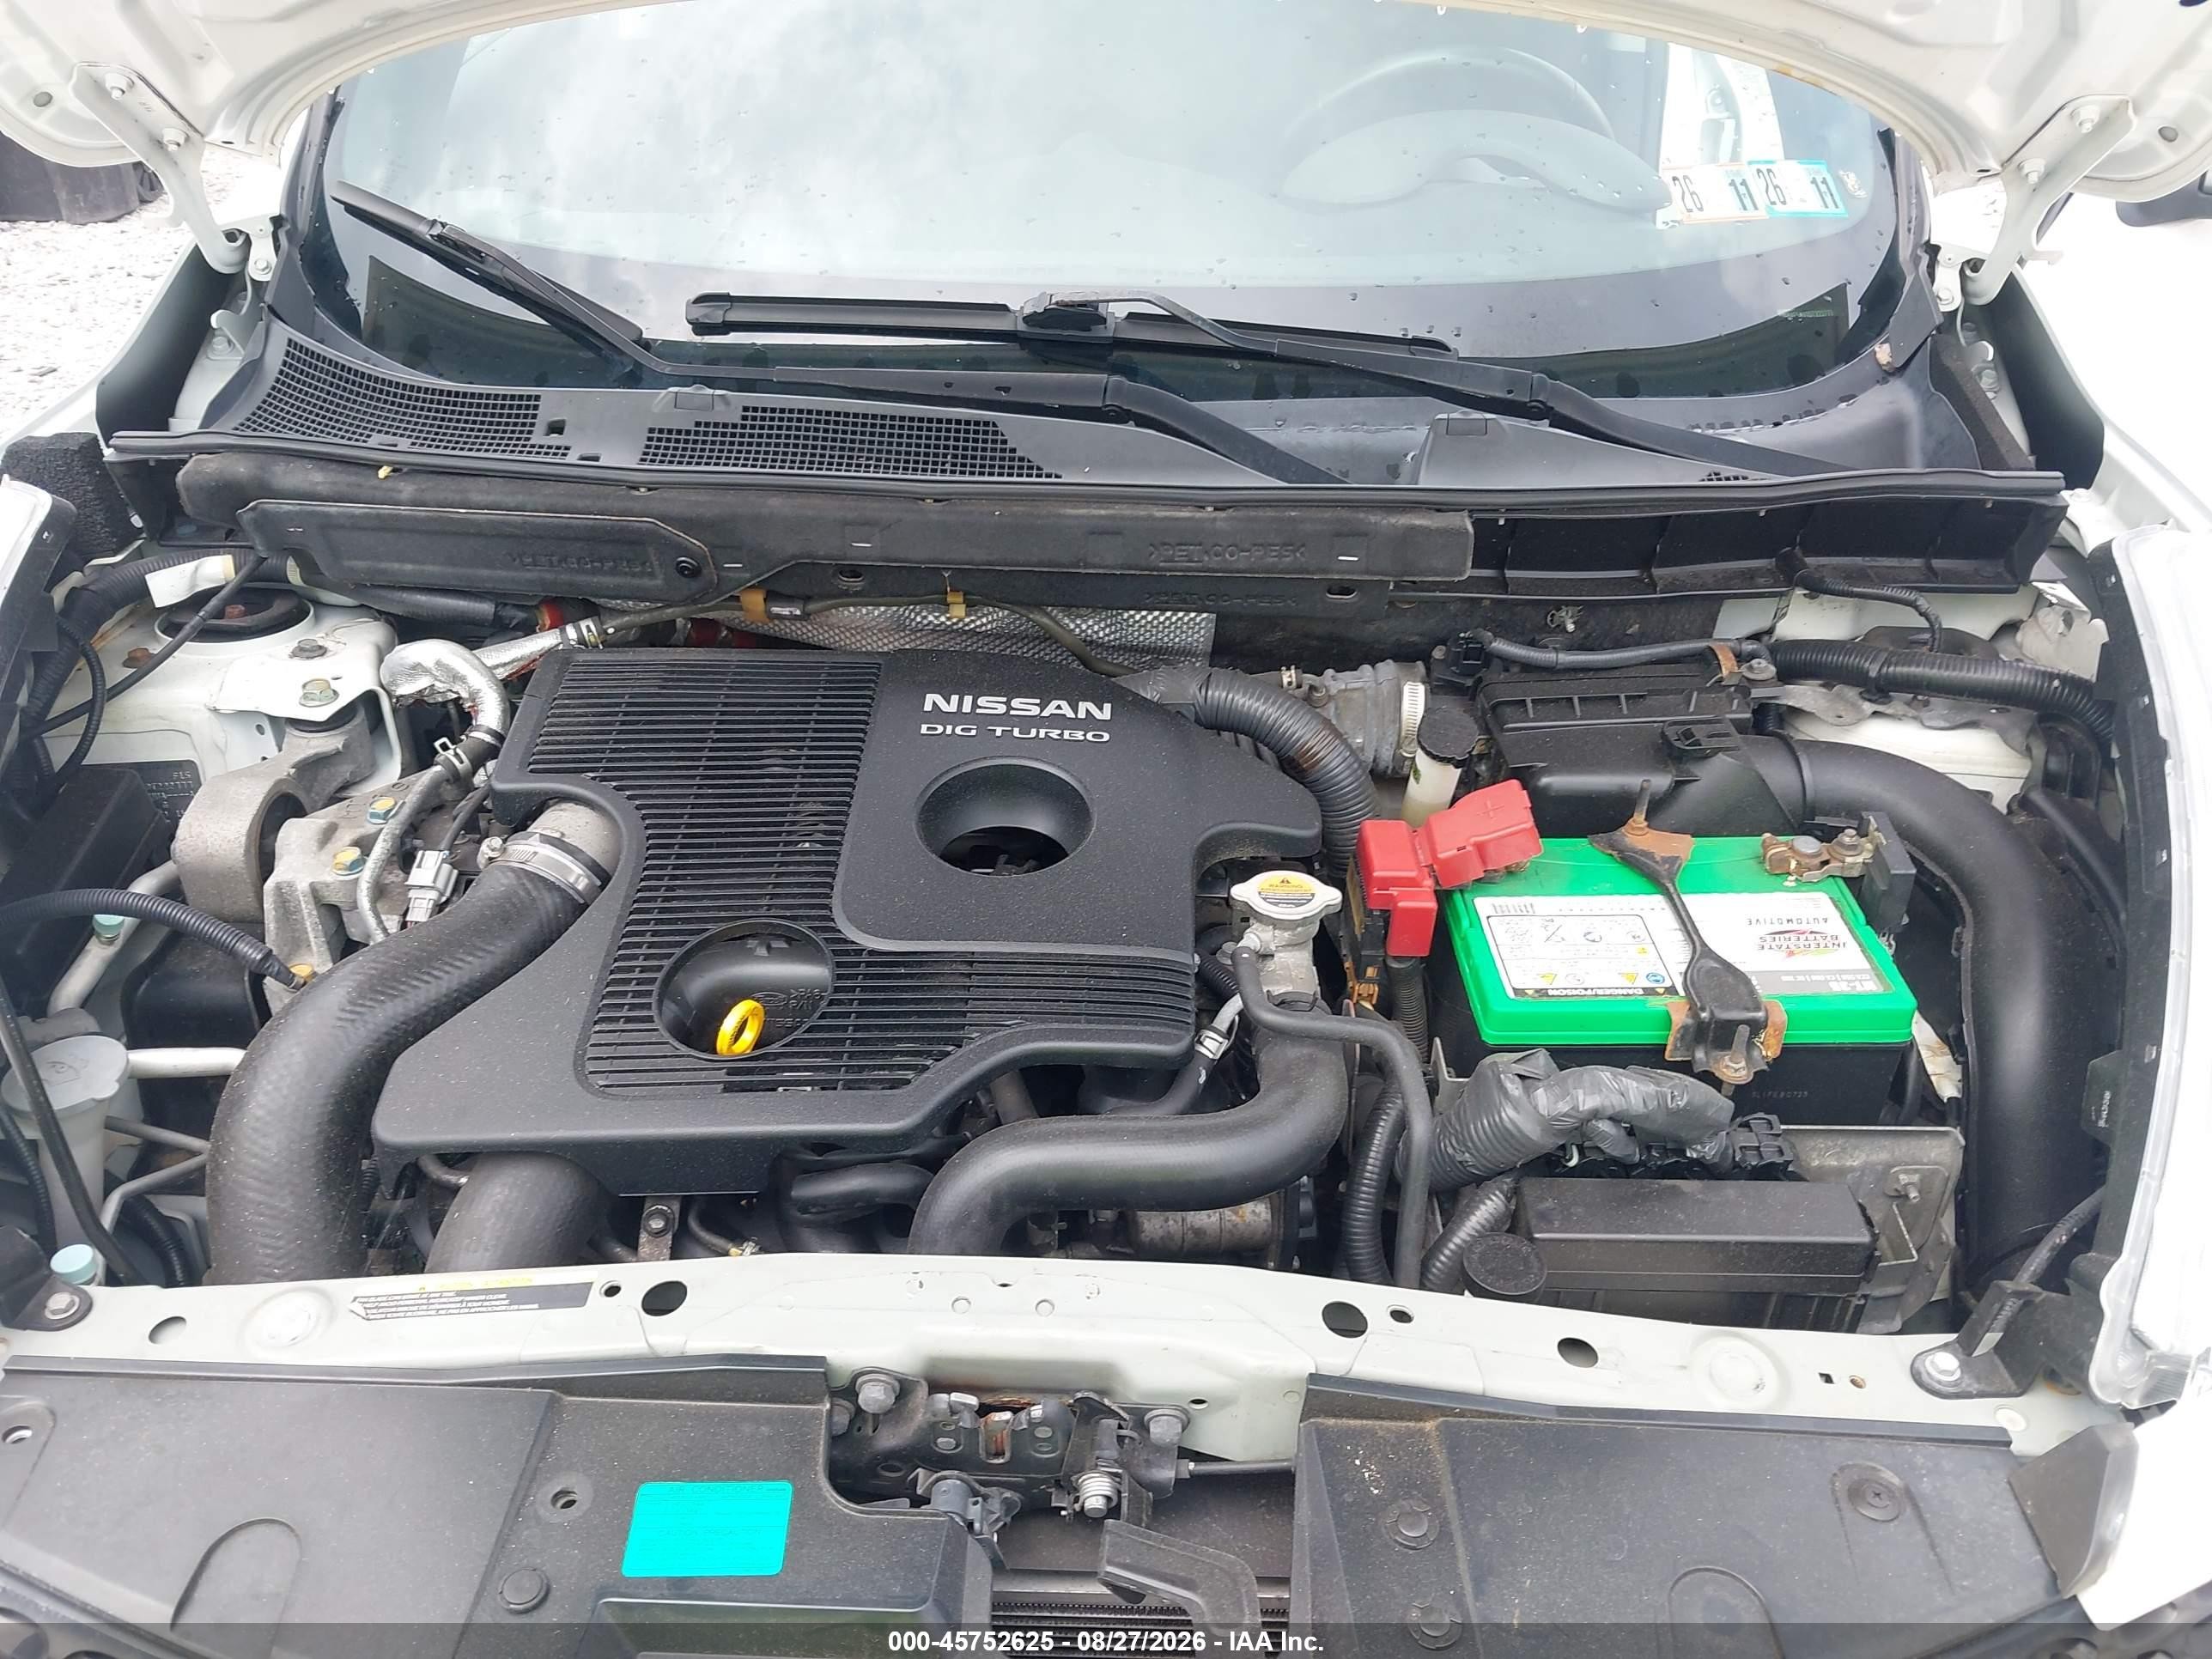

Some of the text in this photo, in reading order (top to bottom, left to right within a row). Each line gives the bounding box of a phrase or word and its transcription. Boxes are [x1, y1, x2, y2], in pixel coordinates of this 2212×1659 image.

[1671, 174, 1704, 213] 26
[1729, 178, 1759, 211] 11
[1755, 167, 1787, 206] 26
[1810, 176, 1839, 210] 11
[923, 693, 1112, 720] NISSAN
[920, 723, 1110, 743] DIG TURBO
[1747, 917, 1828, 926] AUTOMOTIVE
[1758, 942, 1846, 951] INTERSTATE
[1759, 934, 1838, 943] BATTERIES
